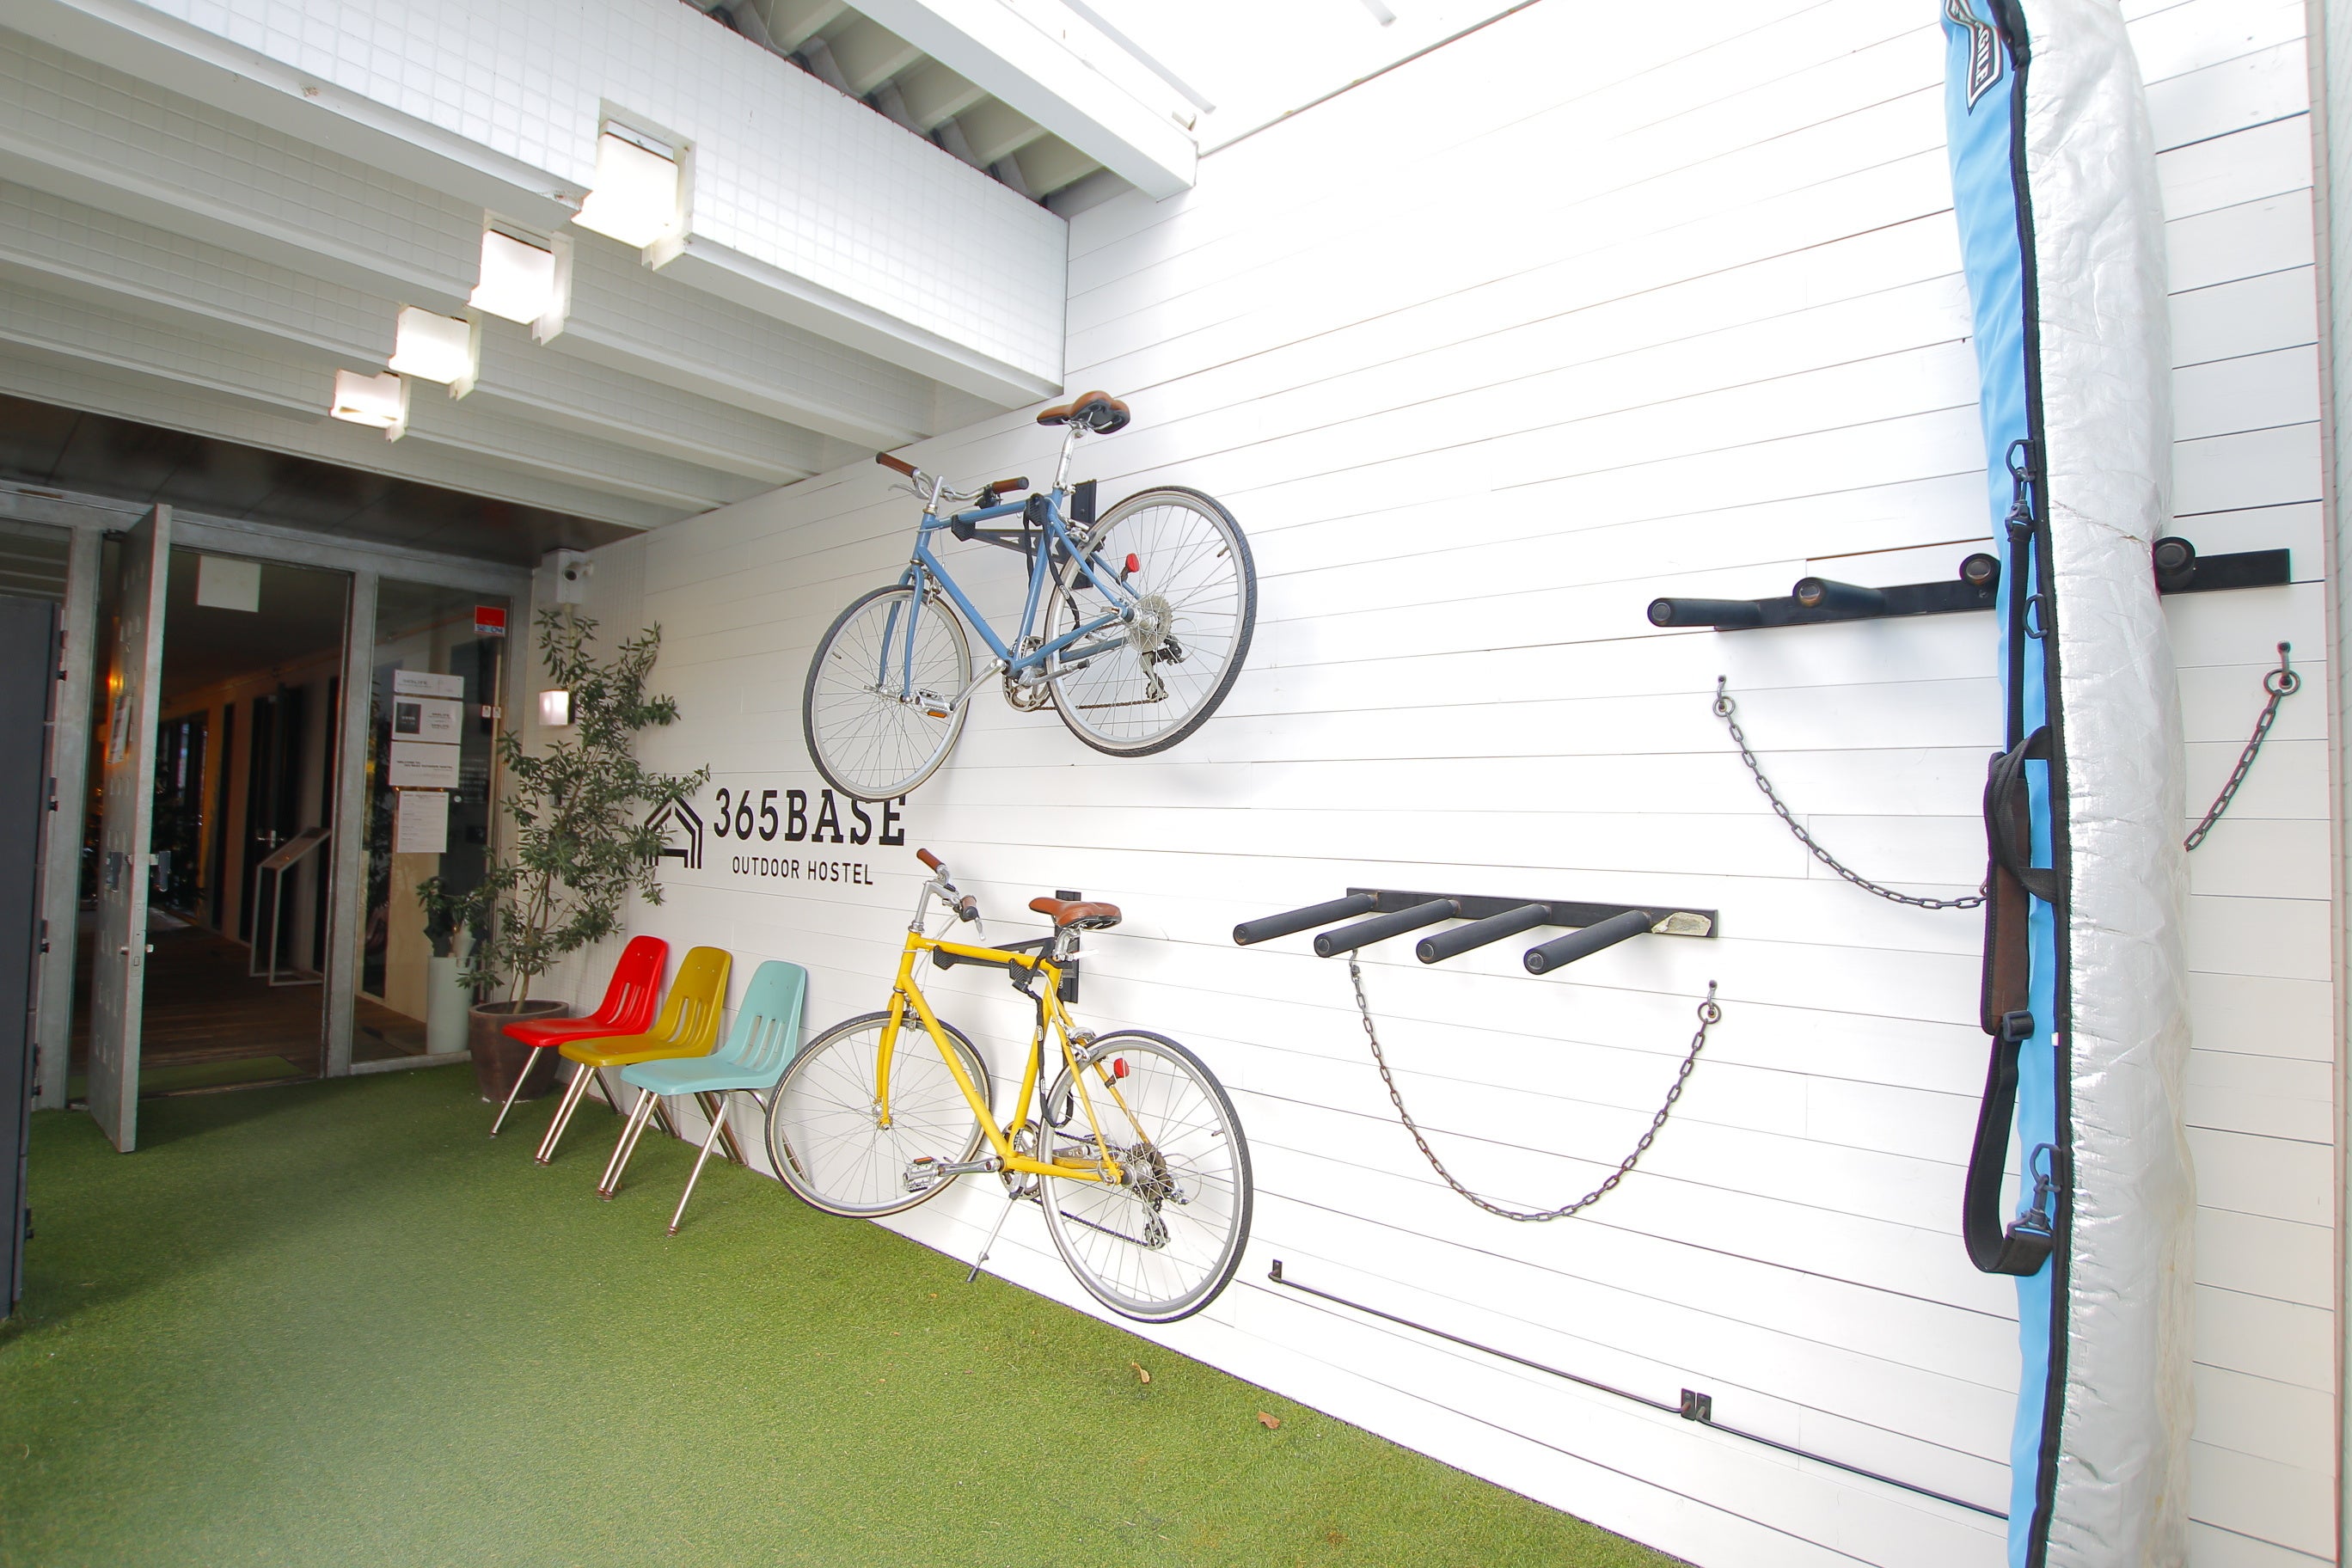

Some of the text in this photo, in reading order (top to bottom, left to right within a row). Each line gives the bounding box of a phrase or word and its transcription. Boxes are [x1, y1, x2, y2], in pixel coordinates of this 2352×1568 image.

[714, 787, 906, 846] 365BASE
[732, 855, 873, 885] OUTDOOR HOSTEL
